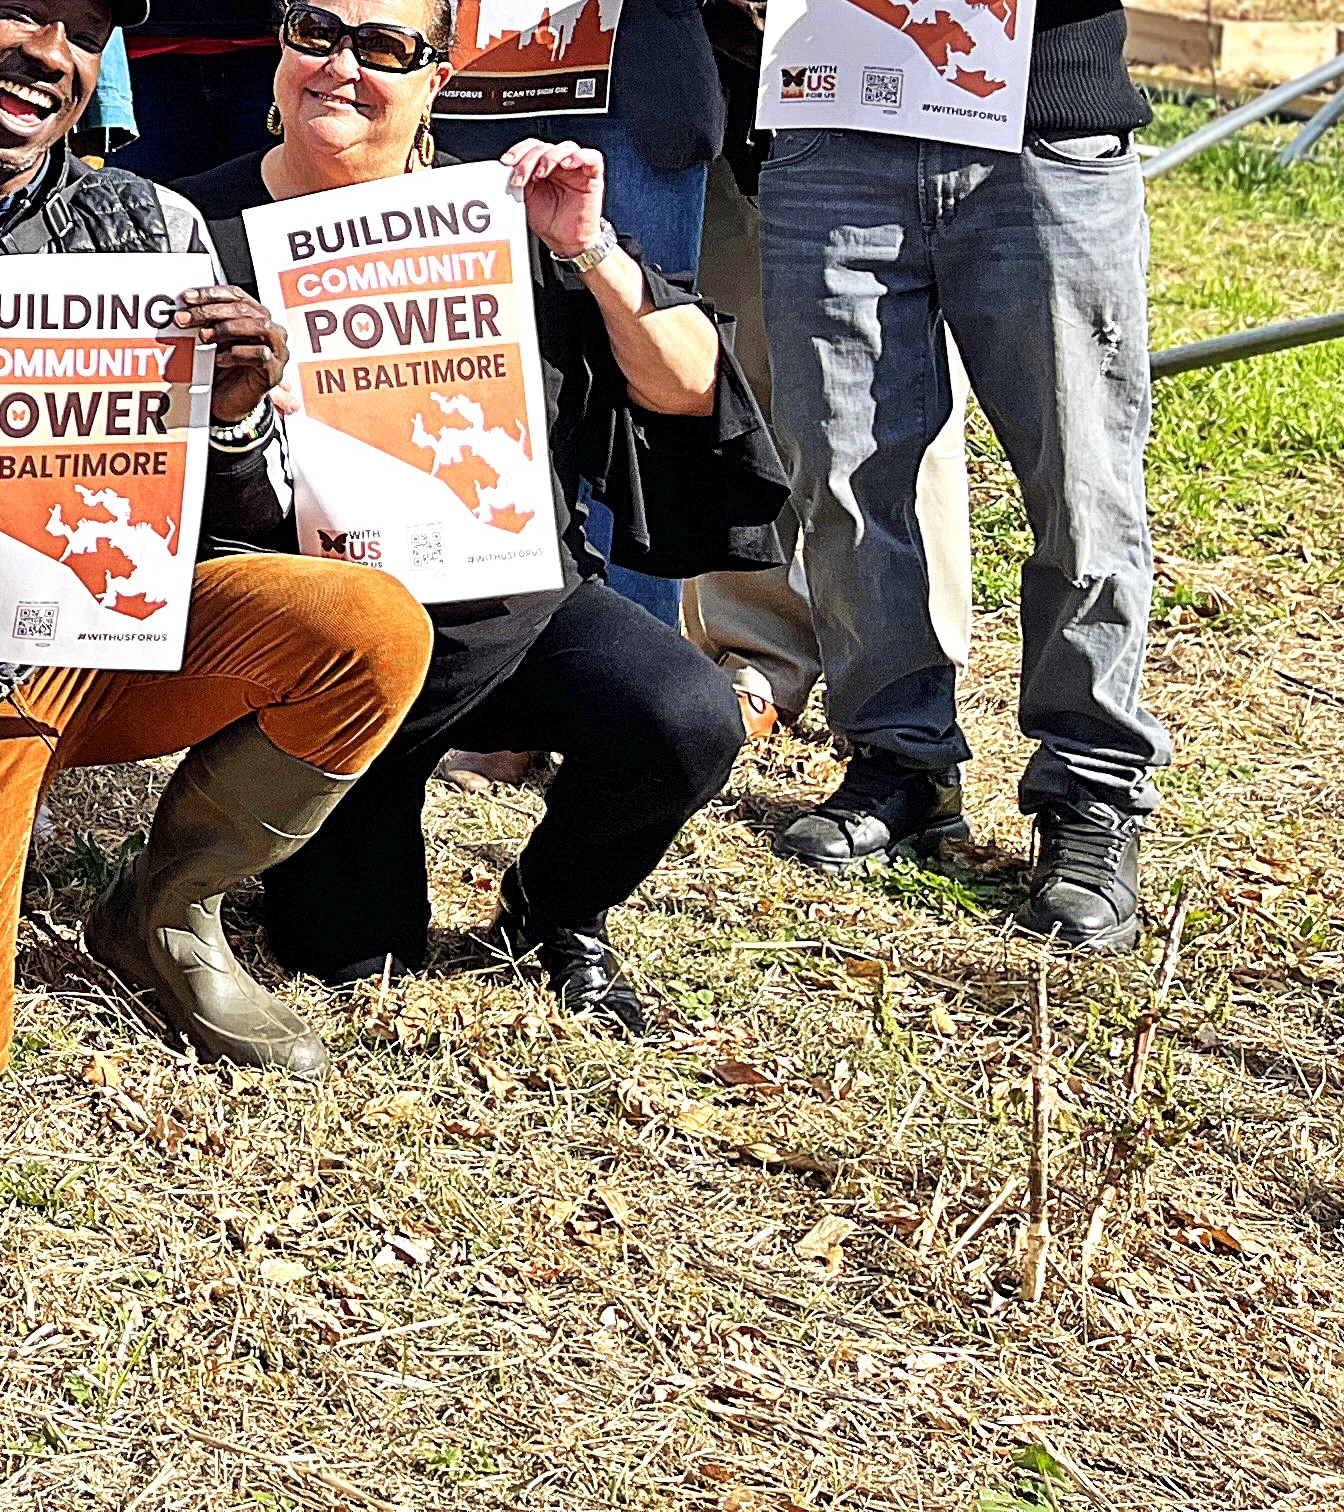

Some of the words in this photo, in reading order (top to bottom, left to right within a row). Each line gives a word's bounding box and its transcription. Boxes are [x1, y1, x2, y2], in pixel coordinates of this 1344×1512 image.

[808, 65, 837, 74] WITH
[807, 75, 836, 91] US
[438, 90, 482, 98] HUSFORUS
[922, 104, 1008, 122] #WITHUSFORUS
[287, 199, 491, 261] BUILDING
[297, 250, 497, 298] COMMUNITY
[305, 293, 502, 354] POWER
[315, 368, 345, 395] IN
[353, 354, 507, 391] BALTIMORE
[349, 530, 381, 539] WITH
[349, 540, 382, 560] US
[78, 634, 167, 642] #WITHUSFORUS
